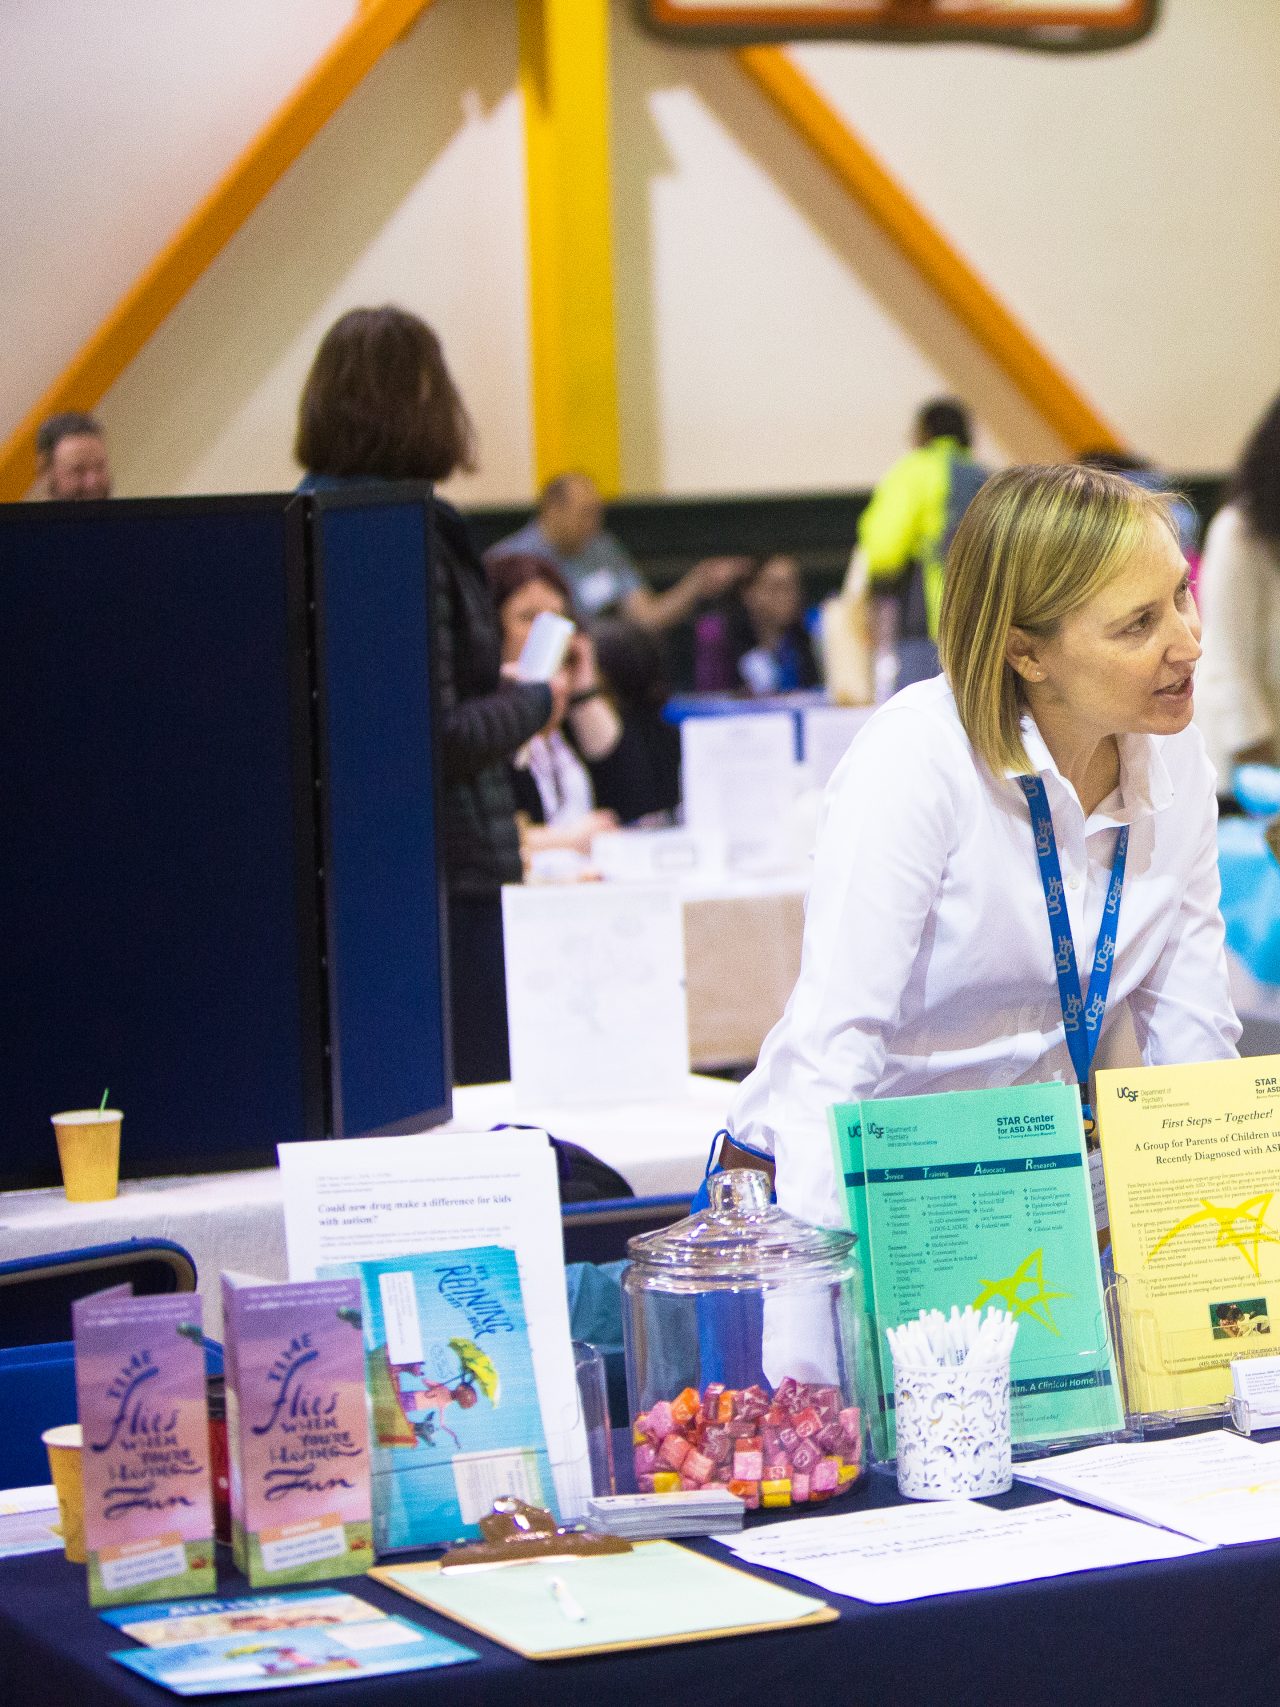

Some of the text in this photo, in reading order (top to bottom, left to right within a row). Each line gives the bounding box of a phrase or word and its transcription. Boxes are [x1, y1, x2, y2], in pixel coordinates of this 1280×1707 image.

[1039, 817, 1055, 857] UCSF
[1049, 877, 1063, 916] UCSF
[1106, 876, 1123, 915] UCSF
[1057, 934, 1075, 975] UCSF
[1095, 933, 1115, 973] UCSF
[1065, 992, 1084, 1033] UCSF
[1085, 991, 1105, 1032] UCSF
[1254, 1076, 1276, 1087] STAR
[1255, 1087, 1264, 1095] for
[1266, 1085, 1280, 1094] ASD
[1116, 1084, 1139, 1104] UCSF
[996, 1112, 1054, 1127] STAR Center
[997, 1122, 1055, 1135] for ASD & NDDs
[1161, 1117, 1184, 1130] First
[1185, 1114, 1213, 1129] Steps
[1224, 1107, 1274, 1125] Together!
[866, 1121, 885, 1140] UCSF
[1134, 1144, 1141, 1153] A
[1143, 1140, 1170, 1153] Group
[1171, 1138, 1183, 1148] for
[1185, 1135, 1218, 1147] Parents
[1220, 1133, 1230, 1143] of
[1230, 1129, 1270, 1142] Children
[1155, 1152, 1192, 1167] Recently
[1194, 1146, 1241, 1163] Diagnosed
[1243, 1144, 1263, 1155] with
[922, 1165, 949, 1179] Training
[972, 1161, 1005, 1175] Advocacy
[1024, 1156, 1057, 1170] Research
[369, 1200, 392, 1213] drug
[394, 1198, 419, 1209] make
[429, 1194, 474, 1207] difference
[477, 1194, 491, 1205] for
[493, 1193, 512, 1204] kids
[432, 1257, 514, 1344] RAINING
[1038, 1381, 1067, 1390] Clinical
[1070, 1377, 1097, 1387] Home.
